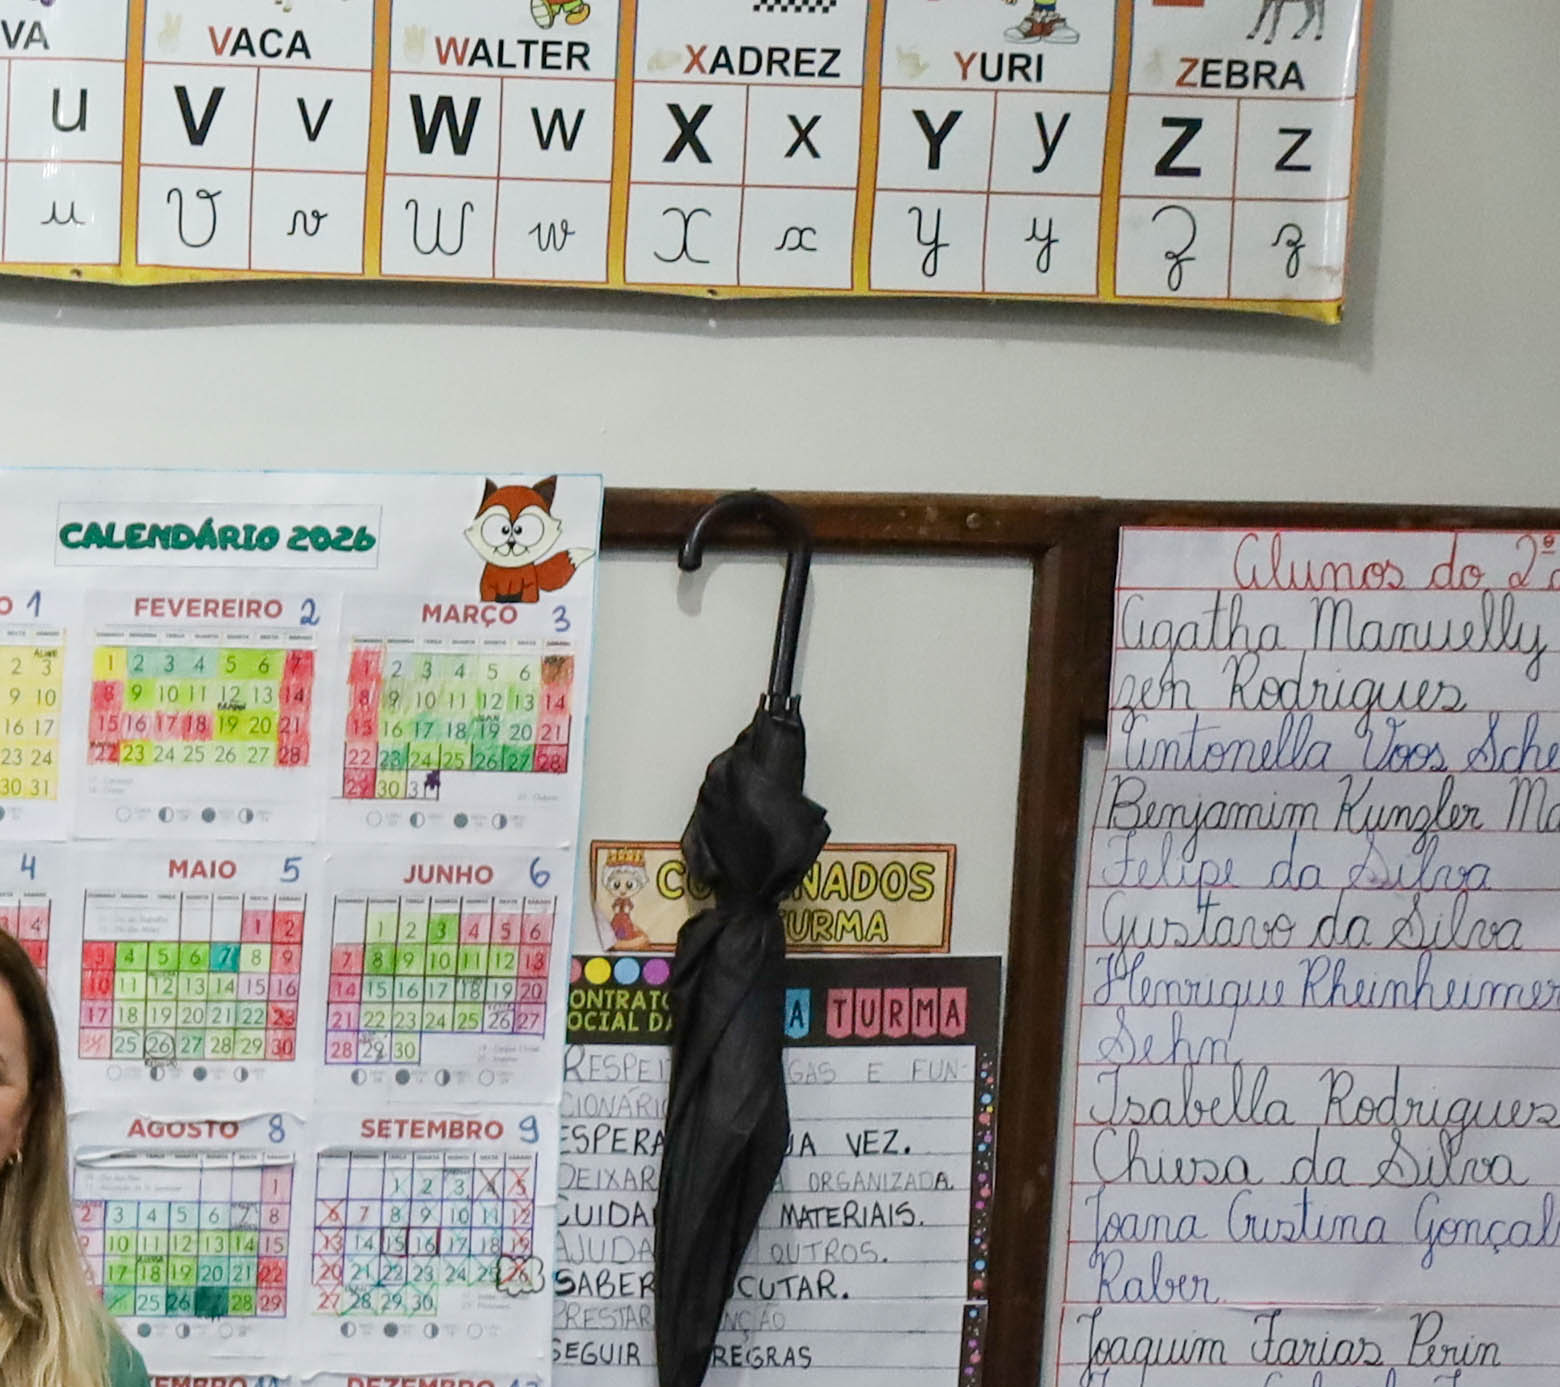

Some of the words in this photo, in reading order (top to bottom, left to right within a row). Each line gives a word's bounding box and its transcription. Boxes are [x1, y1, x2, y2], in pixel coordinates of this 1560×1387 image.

[207, 26, 313, 61] VACA
[434, 36, 592, 72] WALTER
[683, 44, 842, 80] XADREZ
[953, 51, 1044, 84] YURI
[1178, 57, 1306, 93] ZEBRA
[662, 103, 714, 163] X
[912, 109, 964, 170] Y
[1154, 117, 1203, 178] Z
[59, 517, 280, 554] CALENDÁRIO
[286, 526, 377, 554] 2026
[1234, 532, 1406, 590] Alunos
[1428, 530, 1486, 590] do
[134, 598, 284, 620] FEVEREIRO
[421, 603, 519, 630] MARÇO
[1119, 590, 1287, 675] Agatha
[1311, 590, 1548, 681] Manuelly
[1224, 650, 1467, 735] Rodrigues
[168, 858, 238, 881] MAIO
[281, 856, 300, 883] 5
[403, 862, 495, 886] JUNHO
[1102, 831, 1240, 908] Felipe
[1270, 831, 1321, 889] da
[1349, 831, 1491, 891] Silva
[1307, 887, 1372, 949] da
[1385, 890, 1523, 951] Silva
[1094, 952, 1286, 1040] Henrique
[789, 1005, 805, 1028] A
[831, 1003, 961, 1029] TURMA
[1088, 1064, 1296, 1128] Isabella
[128, 1119, 240, 1141] AGOSTO
[360, 1119, 504, 1140] SETEMBRO
[1282, 1126, 1348, 1186] da
[1368, 1129, 1530, 1188] Silva
[781, 1204, 924, 1228] MATERIAIS.
[1085, 1189, 1208, 1268] Joana
[1228, 1187, 1388, 1246] Cristina
[1251, 1311, 1385, 1370] Farias
[1407, 1311, 1502, 1368] Perin
